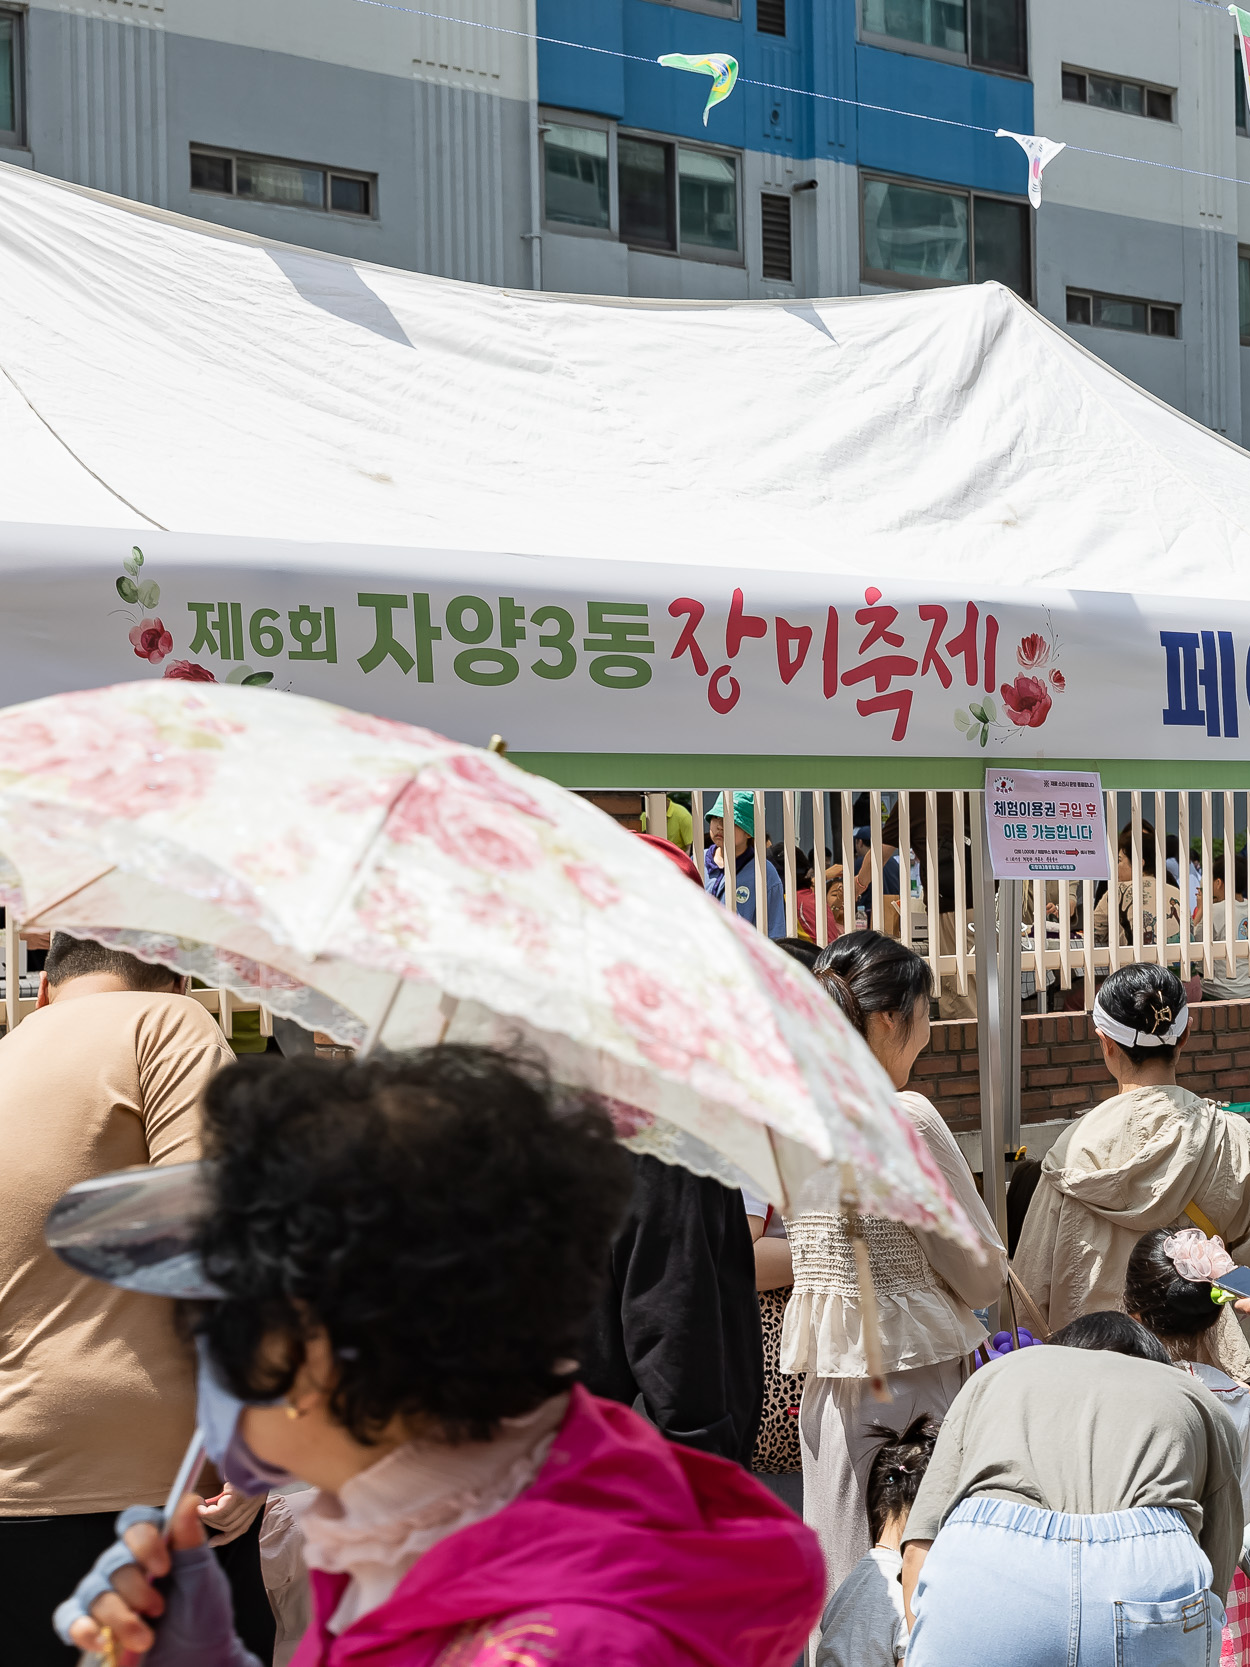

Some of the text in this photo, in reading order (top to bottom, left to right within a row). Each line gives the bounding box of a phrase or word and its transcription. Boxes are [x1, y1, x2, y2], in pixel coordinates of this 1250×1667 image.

[187, 587, 1000, 742] 제6회 자양3동 장미축제
[994, 800, 1097, 818] 체험이용권 구입 후
[1003, 823, 1092, 840] 이용 가능합니다
